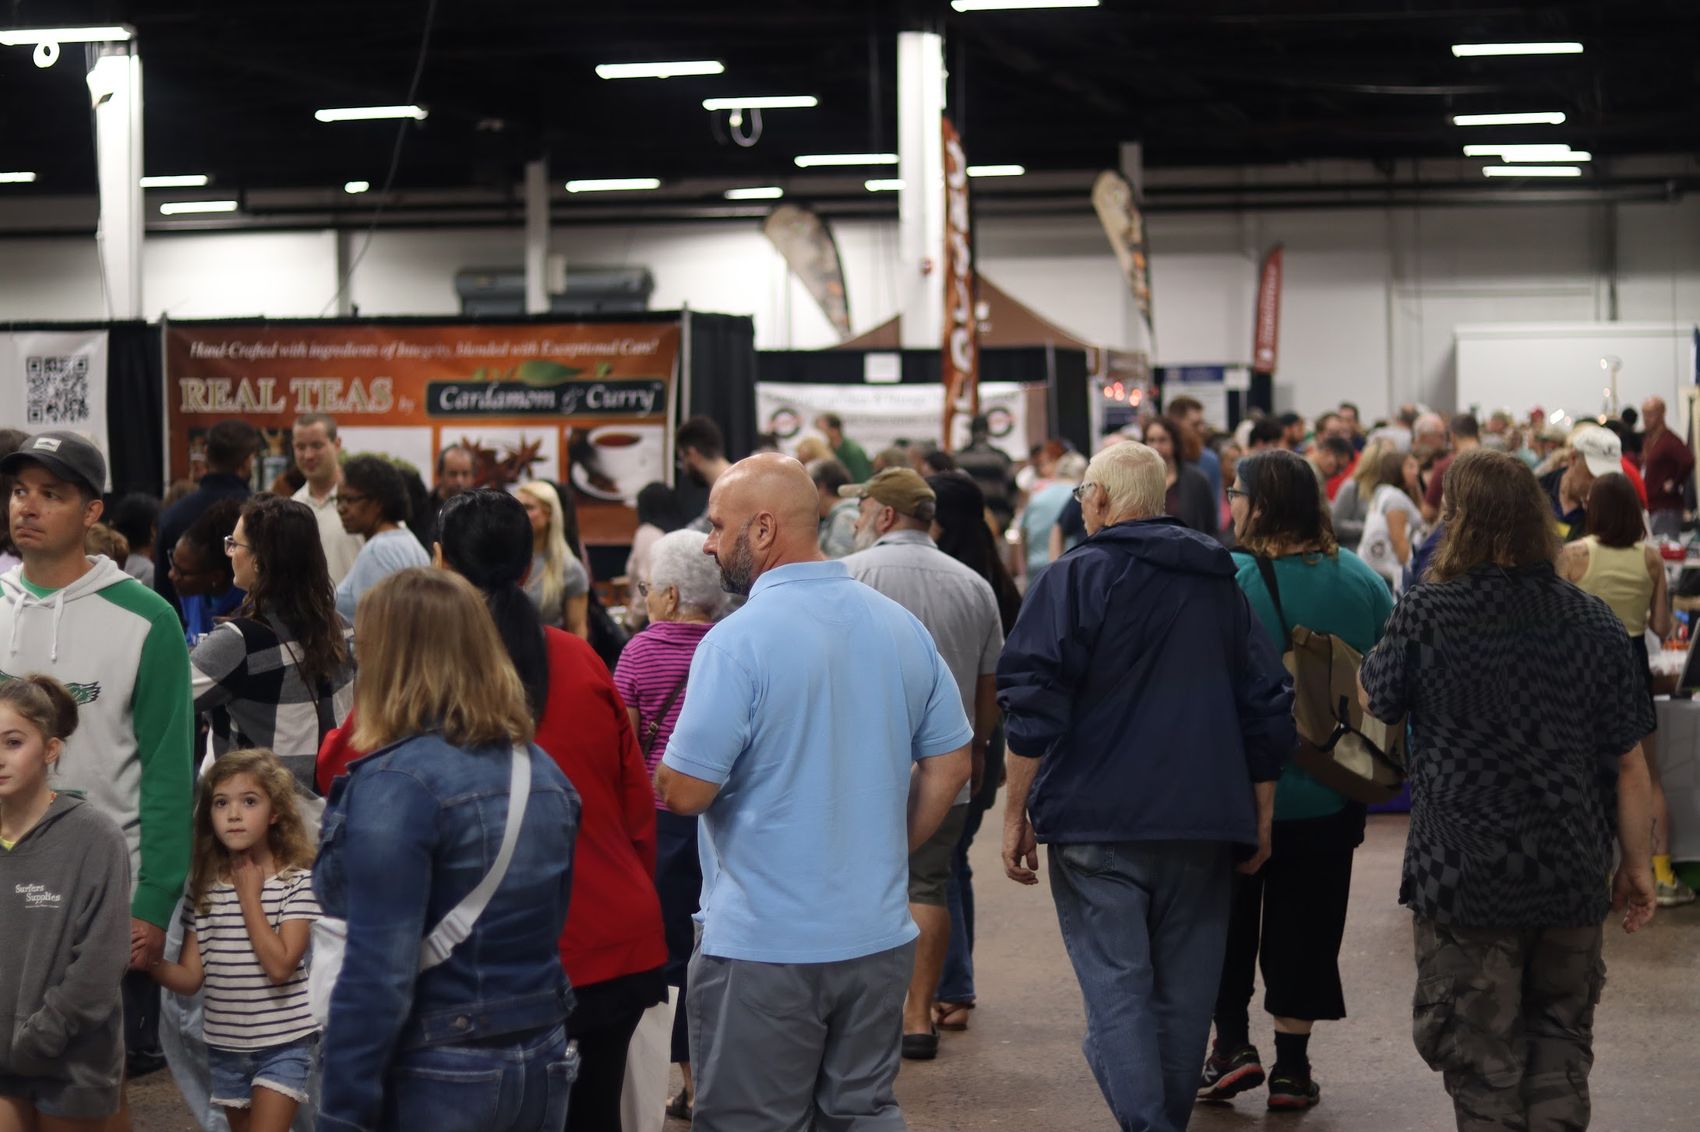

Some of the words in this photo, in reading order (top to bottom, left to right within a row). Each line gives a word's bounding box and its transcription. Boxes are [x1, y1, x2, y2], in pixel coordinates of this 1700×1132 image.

[279, 341, 307, 358] with
[379, 339, 398, 361] of
[511, 340, 537, 357] with
[179, 377, 286, 414] REAL
[289, 376, 394, 414] TEAS
[439, 381, 555, 411] Cardamom
[560, 386, 584, 415] &
[586, 383, 655, 417] Curry
[15, 884, 44, 893] Surfers
[26, 892, 61, 904] Supplies
